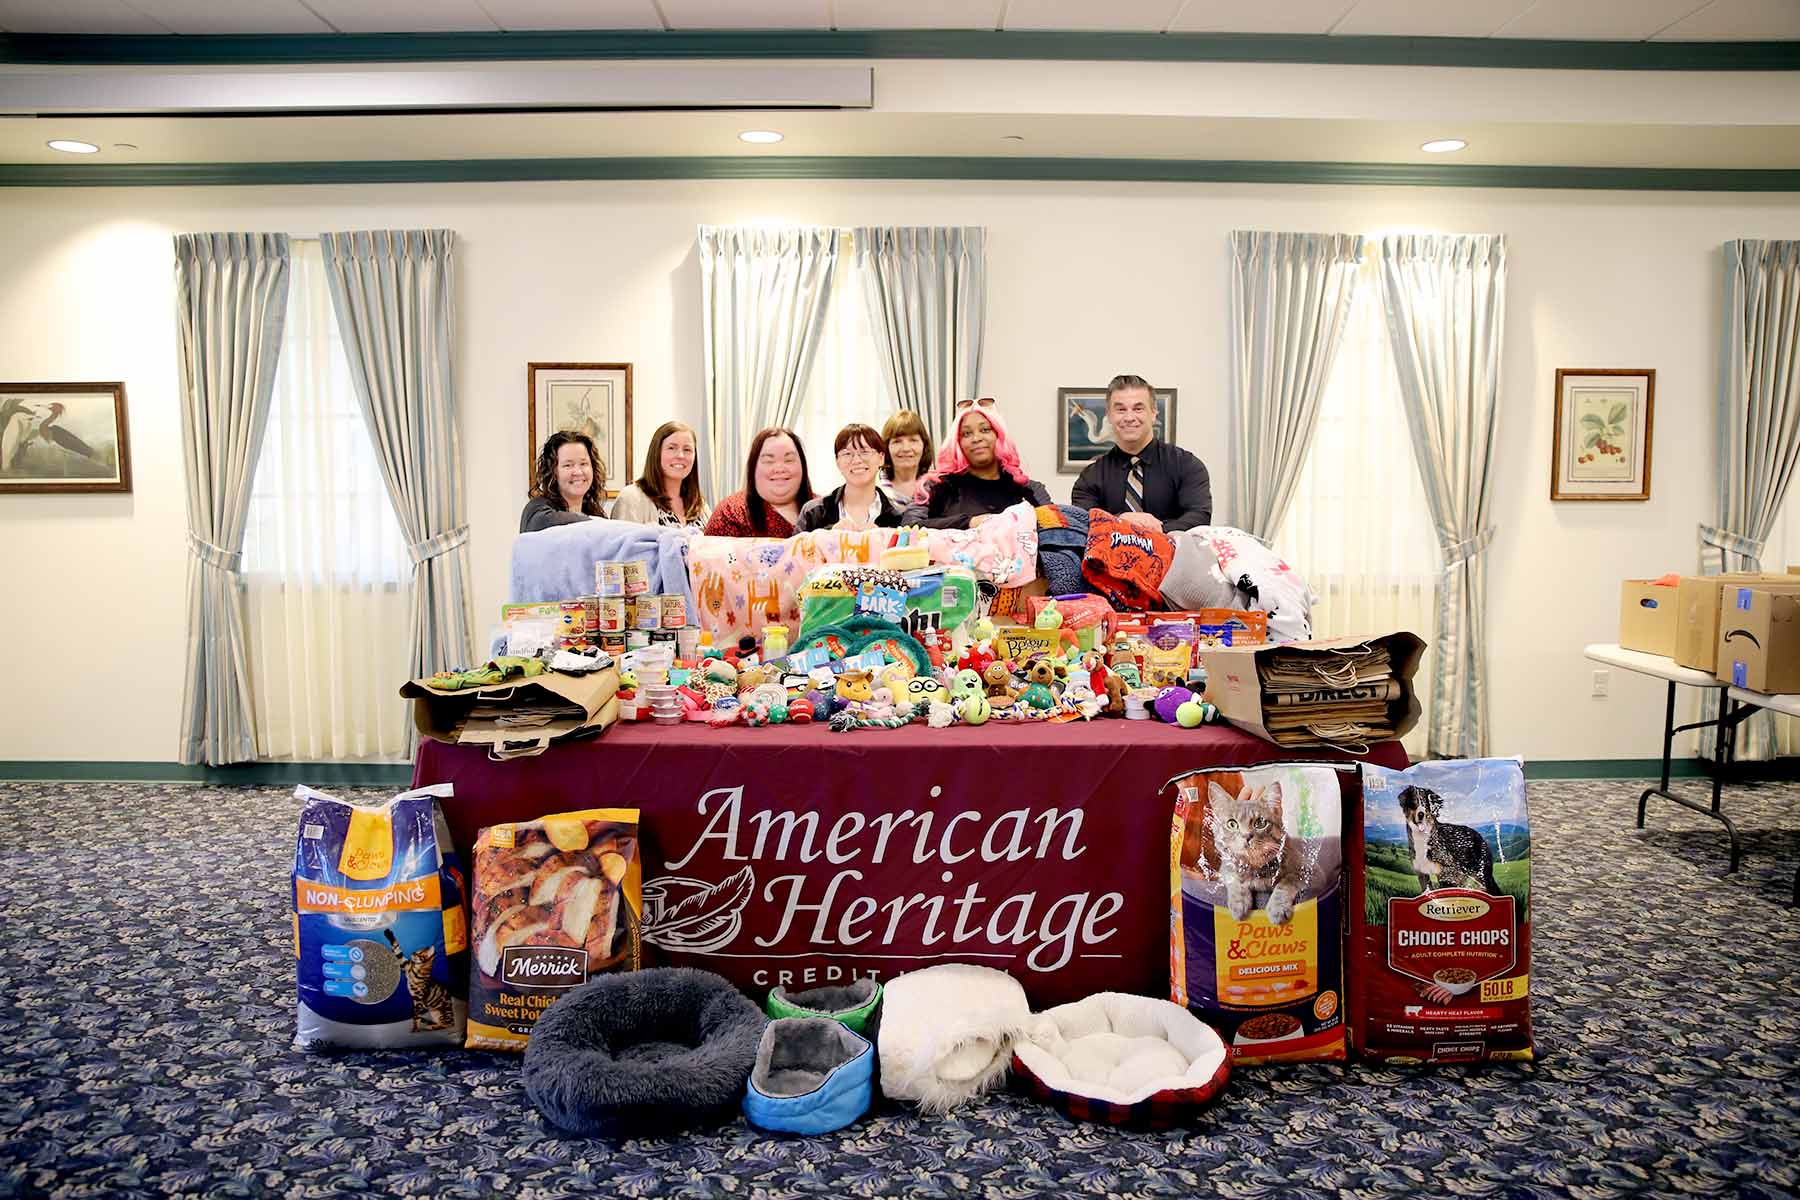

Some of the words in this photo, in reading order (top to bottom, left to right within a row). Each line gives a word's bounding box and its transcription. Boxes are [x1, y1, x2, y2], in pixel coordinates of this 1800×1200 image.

[860, 595, 898, 614] BARK
[664, 784, 1088, 870] American
[1426, 902, 1481, 915] Retriever
[753, 869, 1125, 973] Heritage
[1237, 922, 1294, 939] Paws
[1397, 929, 1456, 946] CHOICE
[1460, 928, 1509, 946] CHOPS
[1245, 940, 1309, 959] Claws
[507, 957, 582, 978] Merrick
[752, 966, 881, 986] CREDIT
[1238, 965, 1281, 976] DELICIOUS
[1282, 962, 1299, 972] MIX
[499, 992, 525, 1008] Real
[484, 1002, 519, 1018] Sweet
[520, 1008, 541, 1021] Pot
